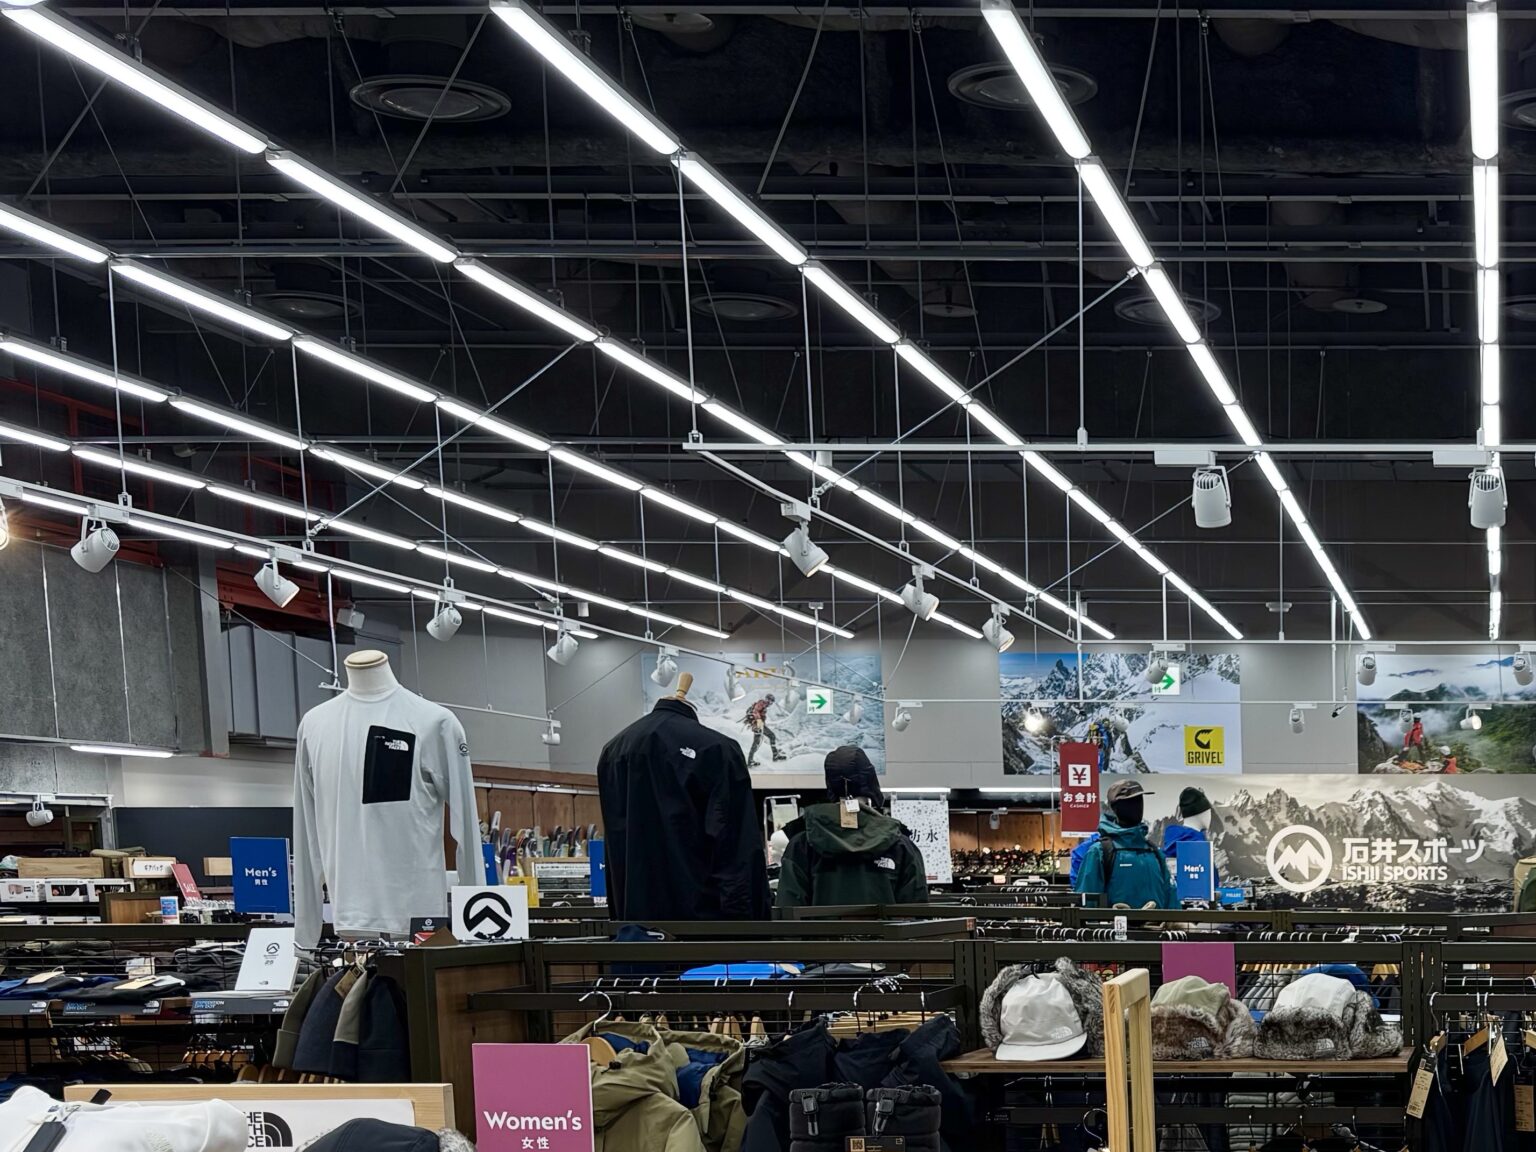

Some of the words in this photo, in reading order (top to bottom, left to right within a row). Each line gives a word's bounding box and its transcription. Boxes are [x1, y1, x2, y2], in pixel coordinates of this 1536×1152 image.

[1187, 751, 1222, 764] GRIVEL
[1072, 767, 1087, 784] ¥
[1063, 792, 1098, 803] お会計
[1342, 837, 1485, 863] 石井スポーツ
[245, 867, 277, 878] Men's
[1184, 864, 1204, 873] Men's
[1342, 866, 1380, 881] ISHII
[1383, 866, 1448, 881] SPORTS
[483, 1110, 582, 1130] Women's
[521, 1136, 550, 1149] 女性
